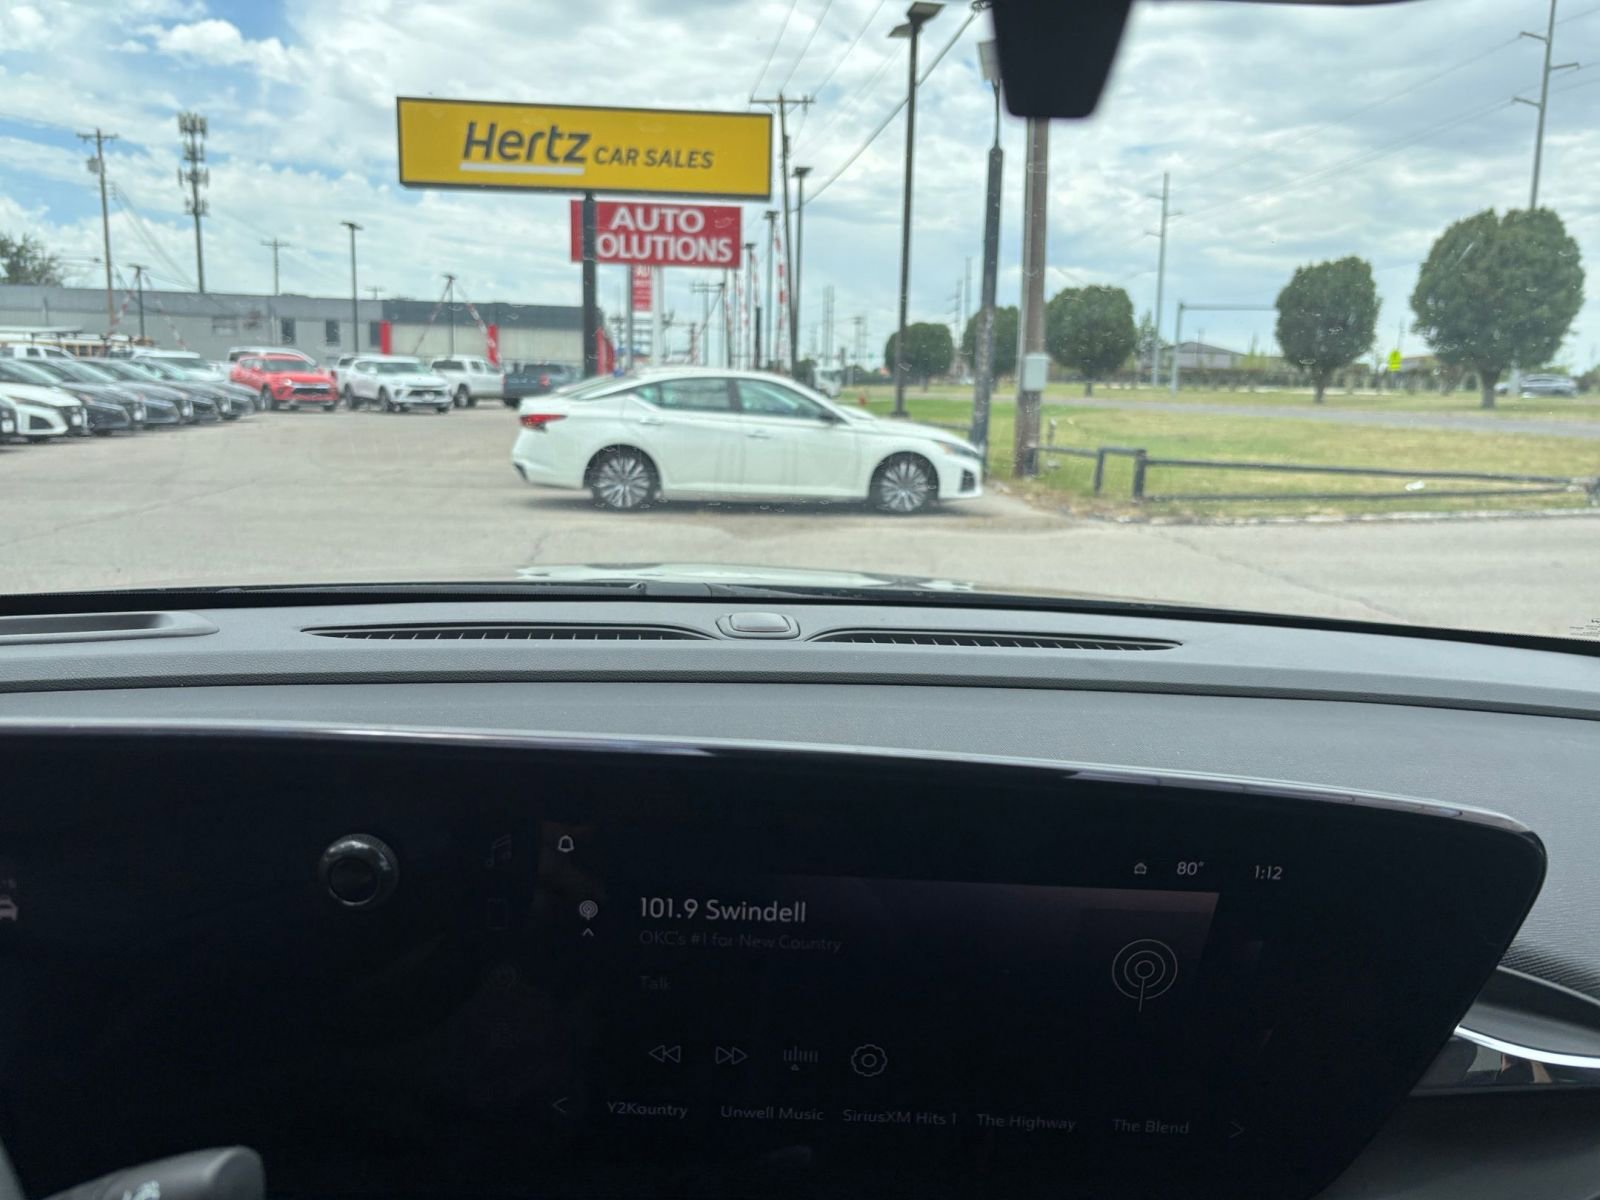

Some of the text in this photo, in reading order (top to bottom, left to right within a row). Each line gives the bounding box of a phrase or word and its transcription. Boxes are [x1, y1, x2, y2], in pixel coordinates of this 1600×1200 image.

[462, 121, 714, 170] Hertz CAR SALES
[609, 205, 706, 233] AUTO
[596, 234, 734, 264] OLUTIONS
[1255, 864, 1283, 881] 1:12
[640, 896, 806, 922] 101.9 Swindell
[711, 933, 736, 947] for
[738, 934, 777, 949] New
[778, 935, 842, 954] Country
[606, 1101, 688, 1120] Y2Kountry
[720, 1105, 824, 1121] Unwell Music
[842, 1107, 912, 1123] SiriusXM
[914, 1111, 946, 1125] Hits
[976, 1113, 1077, 1134] The Highway
[1112, 1118, 1190, 1135] The Blend
